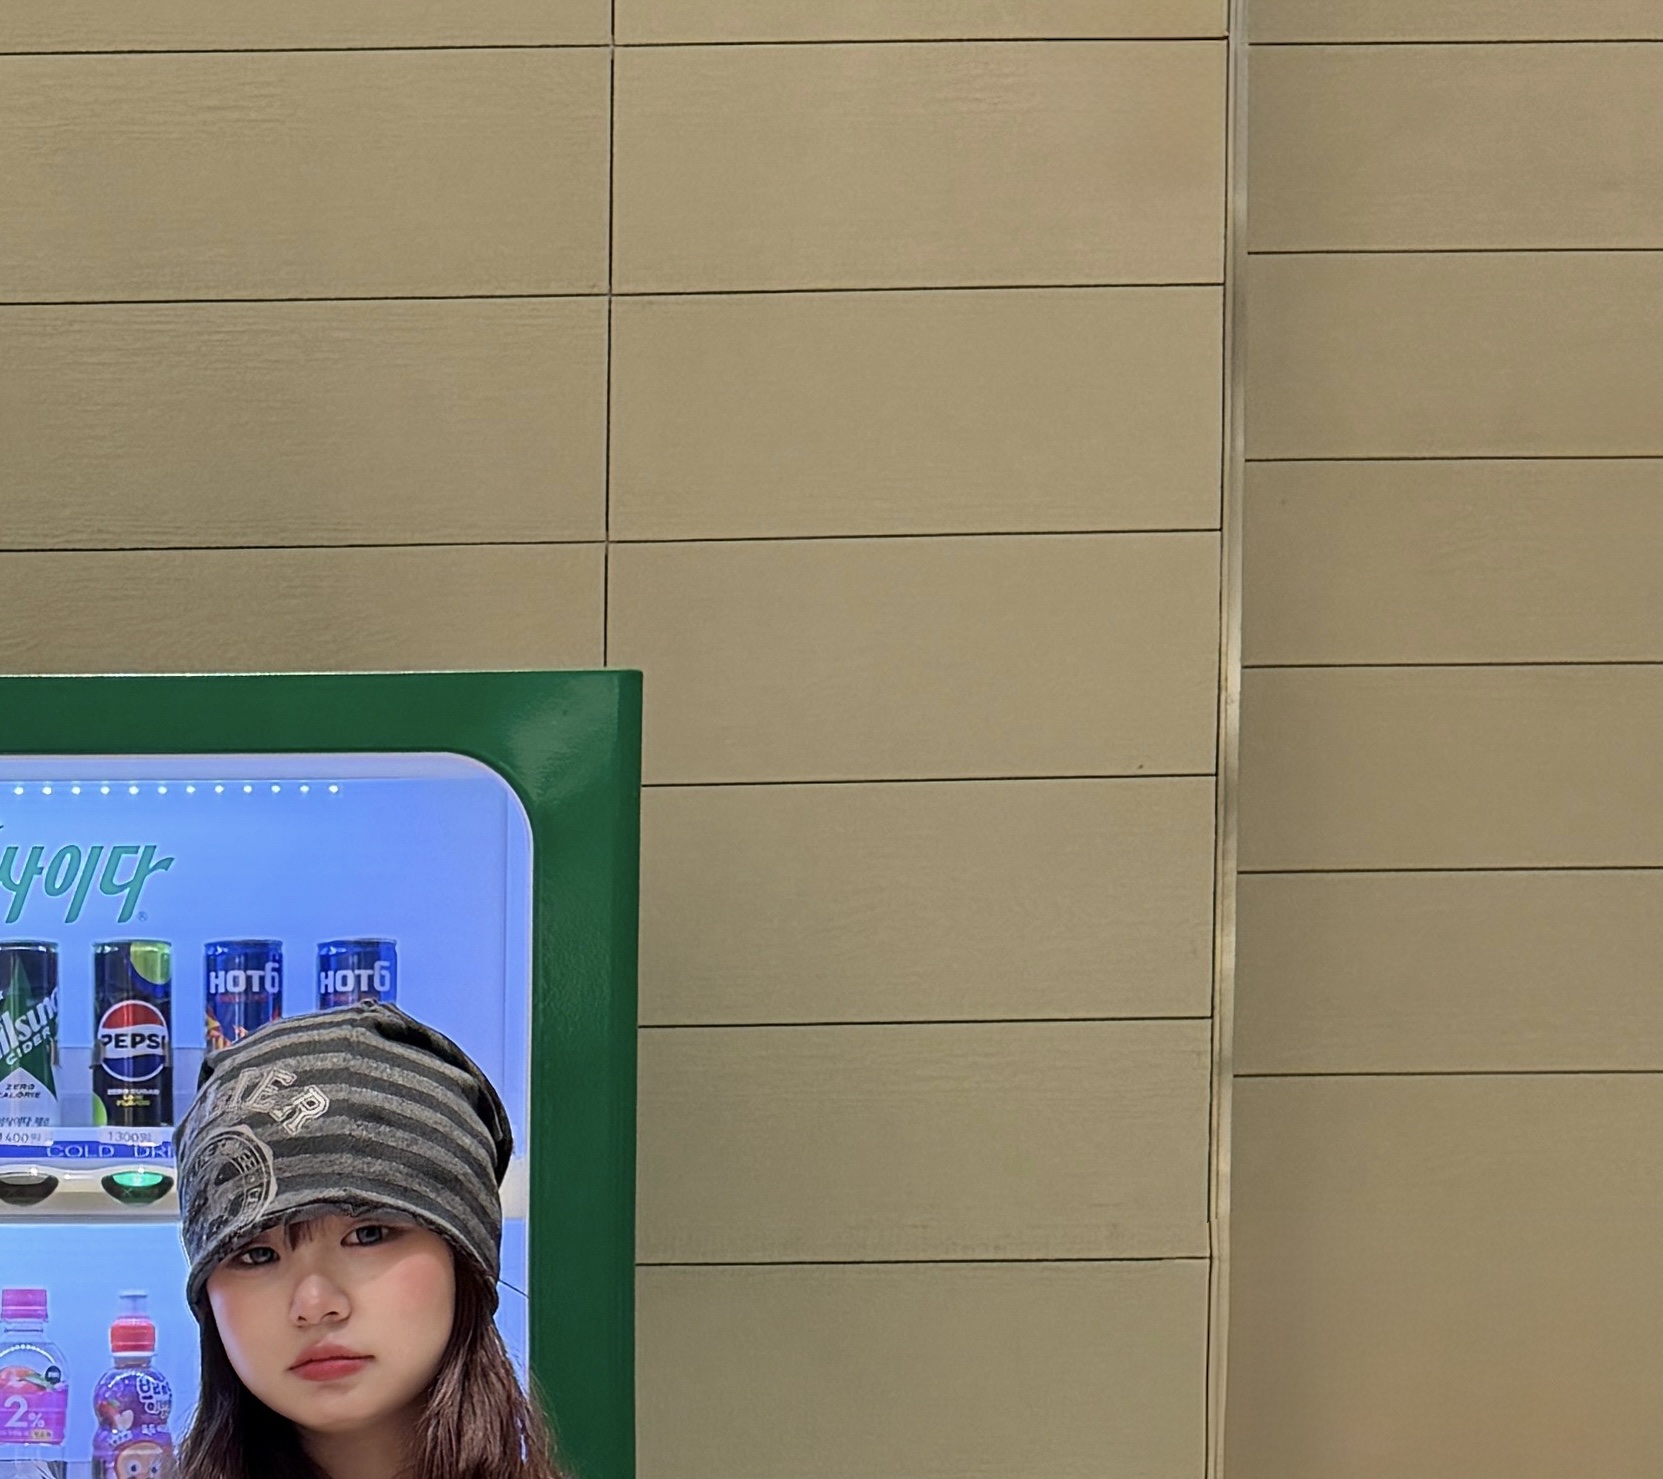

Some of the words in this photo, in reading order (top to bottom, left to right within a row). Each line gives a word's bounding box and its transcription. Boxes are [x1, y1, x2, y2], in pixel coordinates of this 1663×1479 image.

[209, 961, 280, 994] HOT6
[320, 961, 391, 994] HOT6
[134, 1143, 174, 1158] DRI
[4, 1395, 46, 1428] 2%
